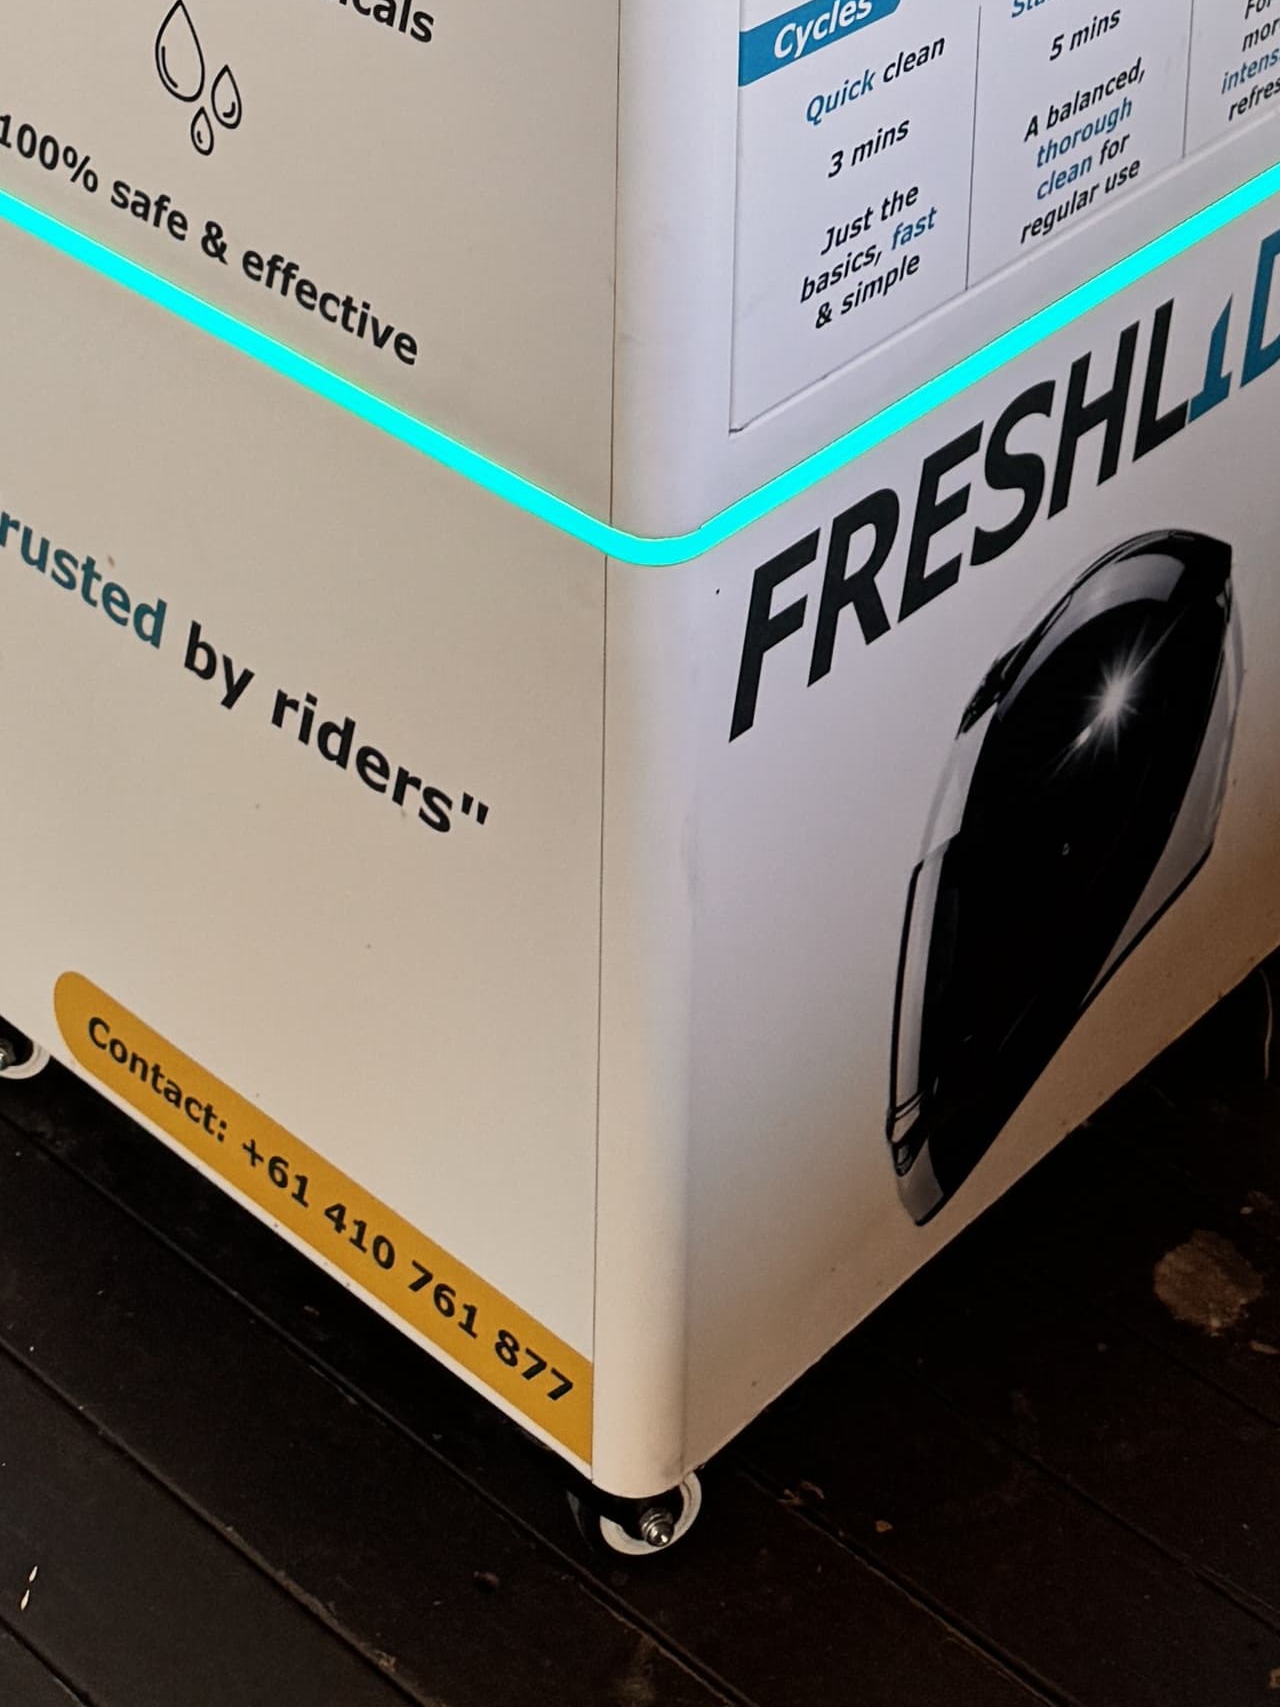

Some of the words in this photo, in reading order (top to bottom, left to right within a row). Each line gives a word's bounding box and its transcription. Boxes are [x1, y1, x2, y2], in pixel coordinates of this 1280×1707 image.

[1049, 36, 1063, 62] 5
[1069, 8, 1121, 51] mins
[805, 71, 875, 125] Quick
[882, 37, 945, 85] clean
[1024, 115, 1039, 141] A
[1046, 58, 1146, 132] balanced,
[828, 152, 842, 178] 3
[849, 118, 909, 169] mins
[1036, 97, 1132, 168] thorough
[1036, 155, 1092, 201] clean
[1098, 132, 1130, 180] for
[821, 206, 873, 255] Just
[880, 183, 919, 226] the
[1020, 181, 1099, 244] regular
[1104, 159, 1141, 198] use
[110, 179, 188, 242] safe
[200, 221, 229, 266] &
[241, 244, 419, 367] effective
[801, 243, 882, 303] basics,
[891, 206, 938, 251] fast
[815, 301, 833, 329] &
[840, 253, 920, 317] simple
[181, 620, 255, 710] by
[269, 687, 491, 834] riders"
[87, 1016, 229, 1144] Contact:
[240, 1135, 311, 1209] +61
[322, 1198, 397, 1272] 410
[408, 1260, 480, 1340] 761
[494, 1325, 575, 1404] 877
